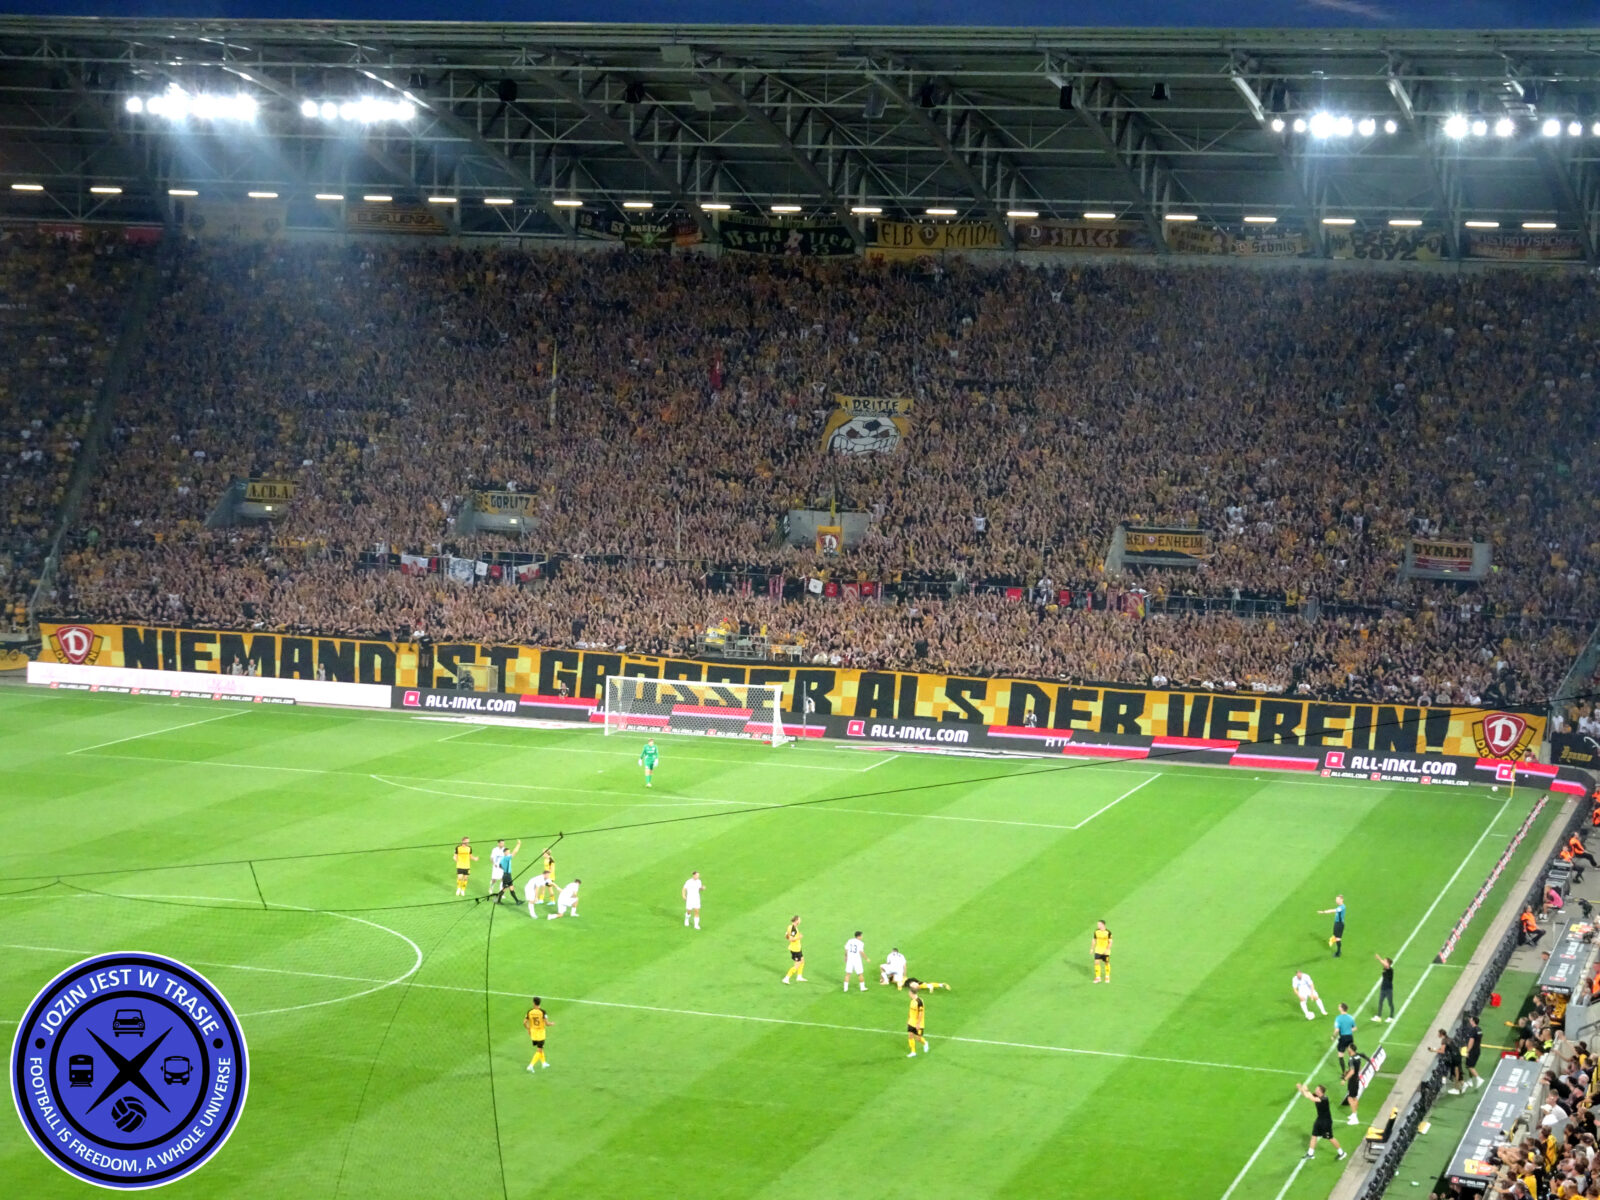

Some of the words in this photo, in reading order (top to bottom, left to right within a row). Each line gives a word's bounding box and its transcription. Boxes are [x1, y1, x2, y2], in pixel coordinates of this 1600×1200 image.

[630, 224, 668, 233] FREITAL
[882, 223, 913, 247] ELB
[852, 399, 899, 412] DRITTE
[64, 629, 90, 657] D
[123, 627, 396, 683] NIEMAND
[418, 643, 520, 694] IST
[538, 650, 836, 715] GRÖSSER
[854, 672, 988, 726] ALS
[1007, 682, 1147, 736] DER
[1166, 693, 1451, 755] VEREIN!
[425, 694, 517, 713] ALL-INKL.COM
[871, 724, 969, 743] ALL-INKL.COM
[1488, 716, 1518, 748] D
[1351, 756, 1458, 776] ALL-INKL.COM
[849, 944, 858, 954] 13
